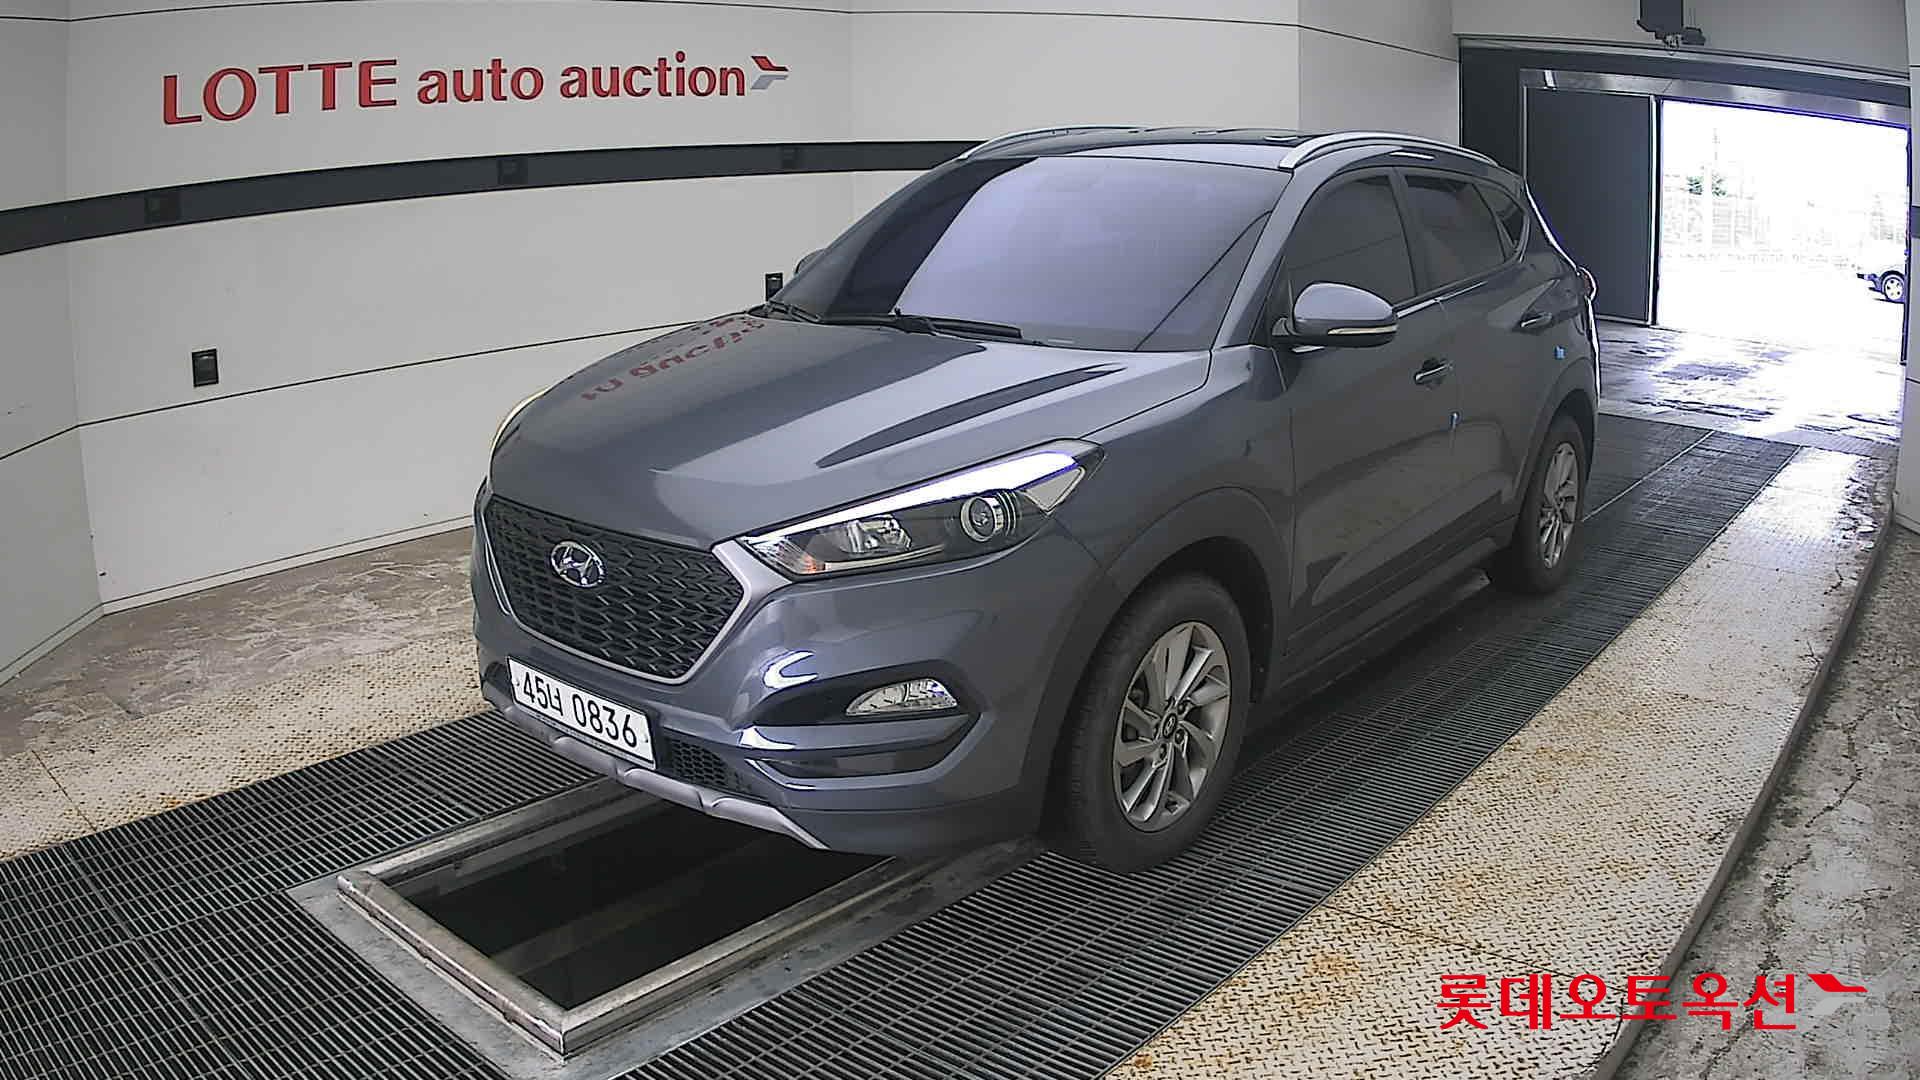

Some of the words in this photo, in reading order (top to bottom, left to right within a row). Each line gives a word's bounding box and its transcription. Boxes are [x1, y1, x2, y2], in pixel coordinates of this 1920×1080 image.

[163, 59, 398, 125] LOTTE
[418, 58, 544, 104] auto
[561, 51, 746, 98] auction
[523, 671, 564, 716] 45너
[572, 693, 637, 747] 0836
